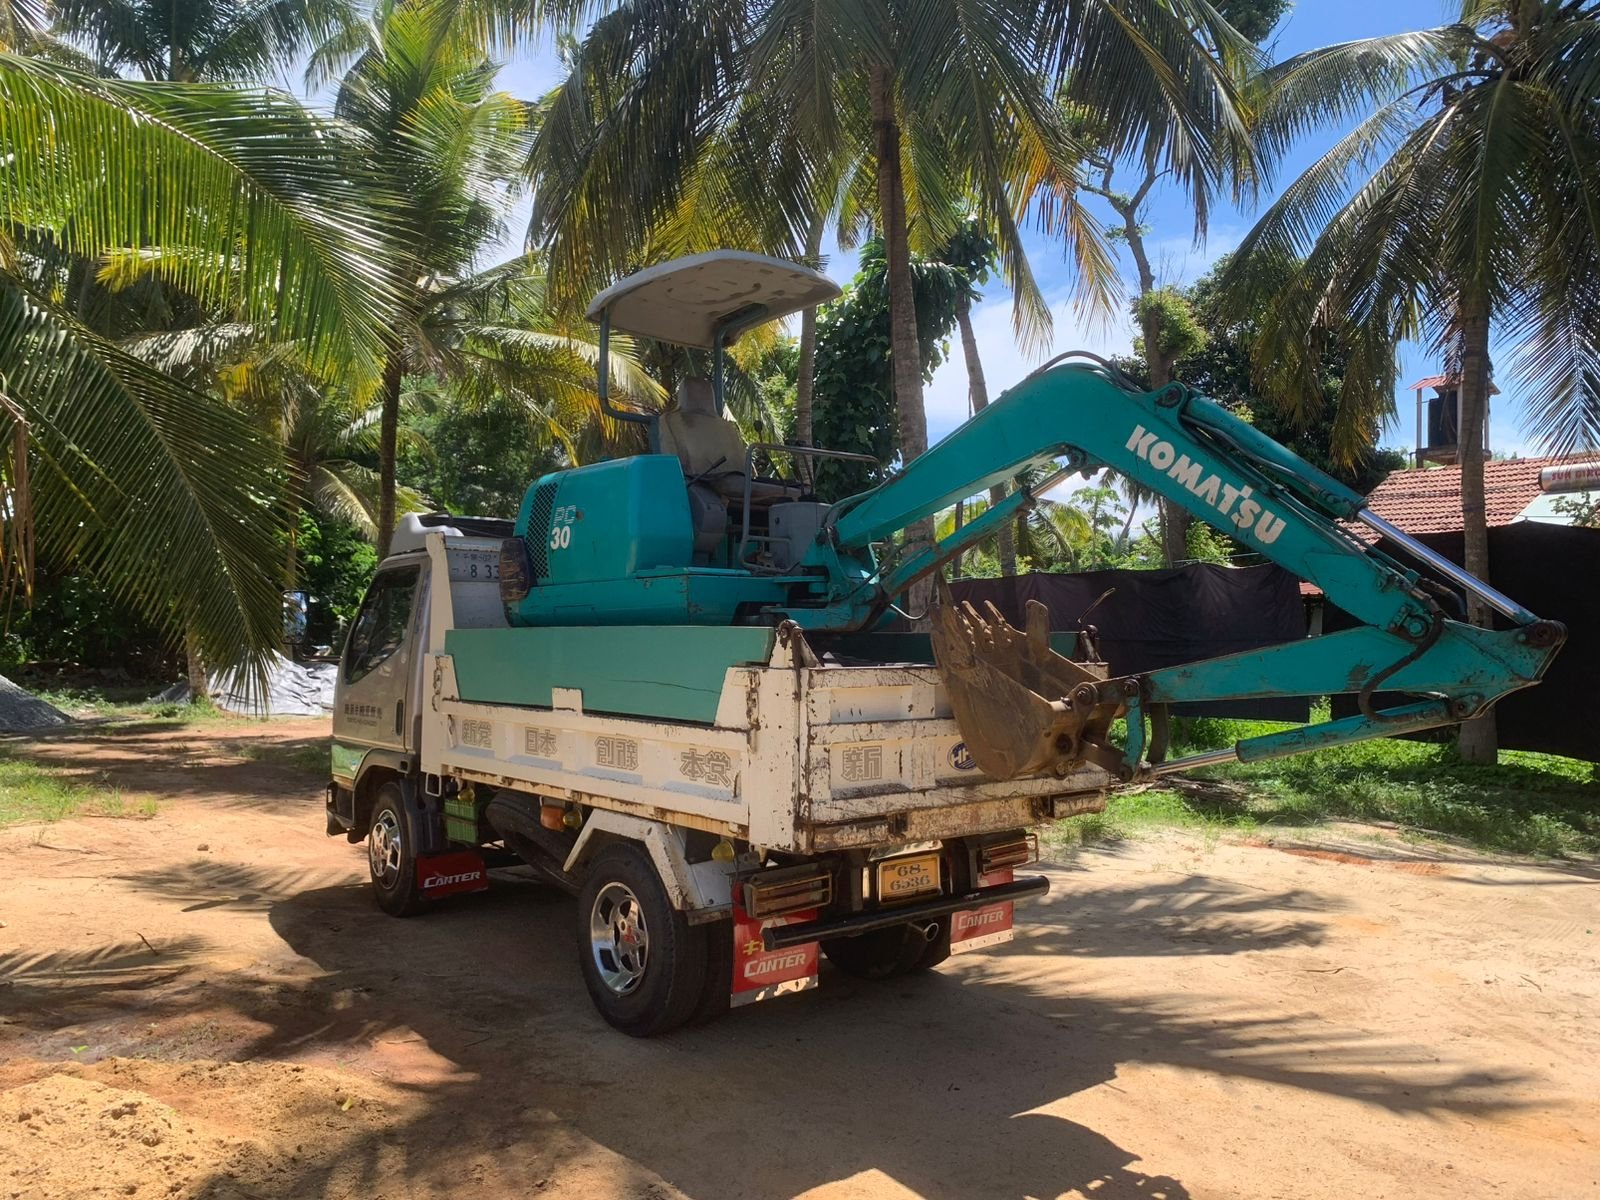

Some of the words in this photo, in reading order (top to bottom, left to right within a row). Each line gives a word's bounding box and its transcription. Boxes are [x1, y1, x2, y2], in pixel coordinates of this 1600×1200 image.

[1125, 424, 1287, 544] KOMATSU
[550, 525, 571, 550] 30
[424, 871, 481, 888] CANTER
[958, 909, 1005, 930] CANTER
[743, 952, 807, 978] CANTER
